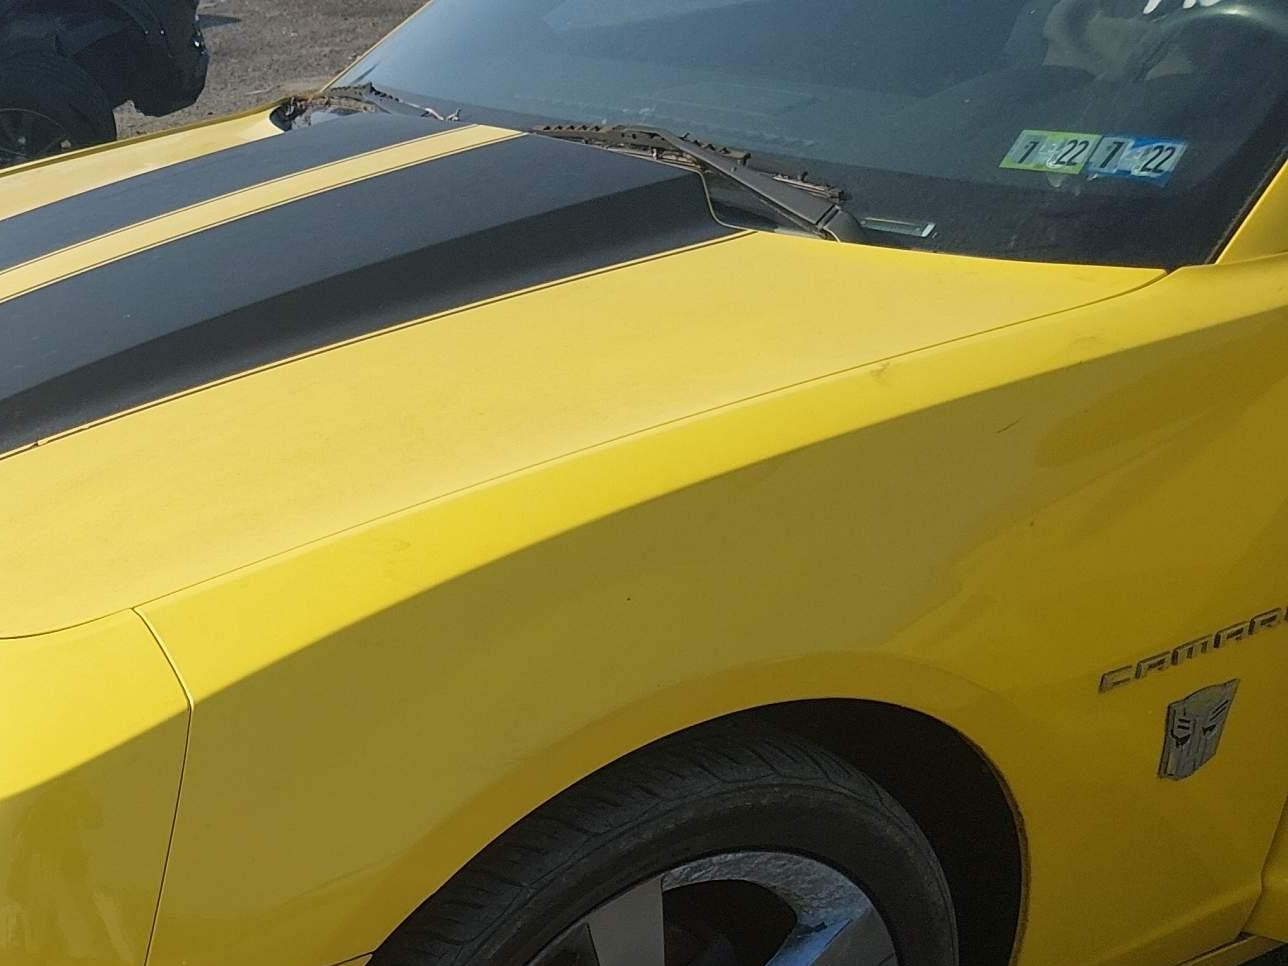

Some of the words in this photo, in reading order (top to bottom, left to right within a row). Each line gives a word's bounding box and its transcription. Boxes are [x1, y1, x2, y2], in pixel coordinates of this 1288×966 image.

[1017, 140, 1040, 164] 7
[1054, 139, 1090, 167] 22
[1099, 141, 1124, 169] 7
[1139, 144, 1177, 173] 22
[1098, 606, 1288, 693] CAMAR
